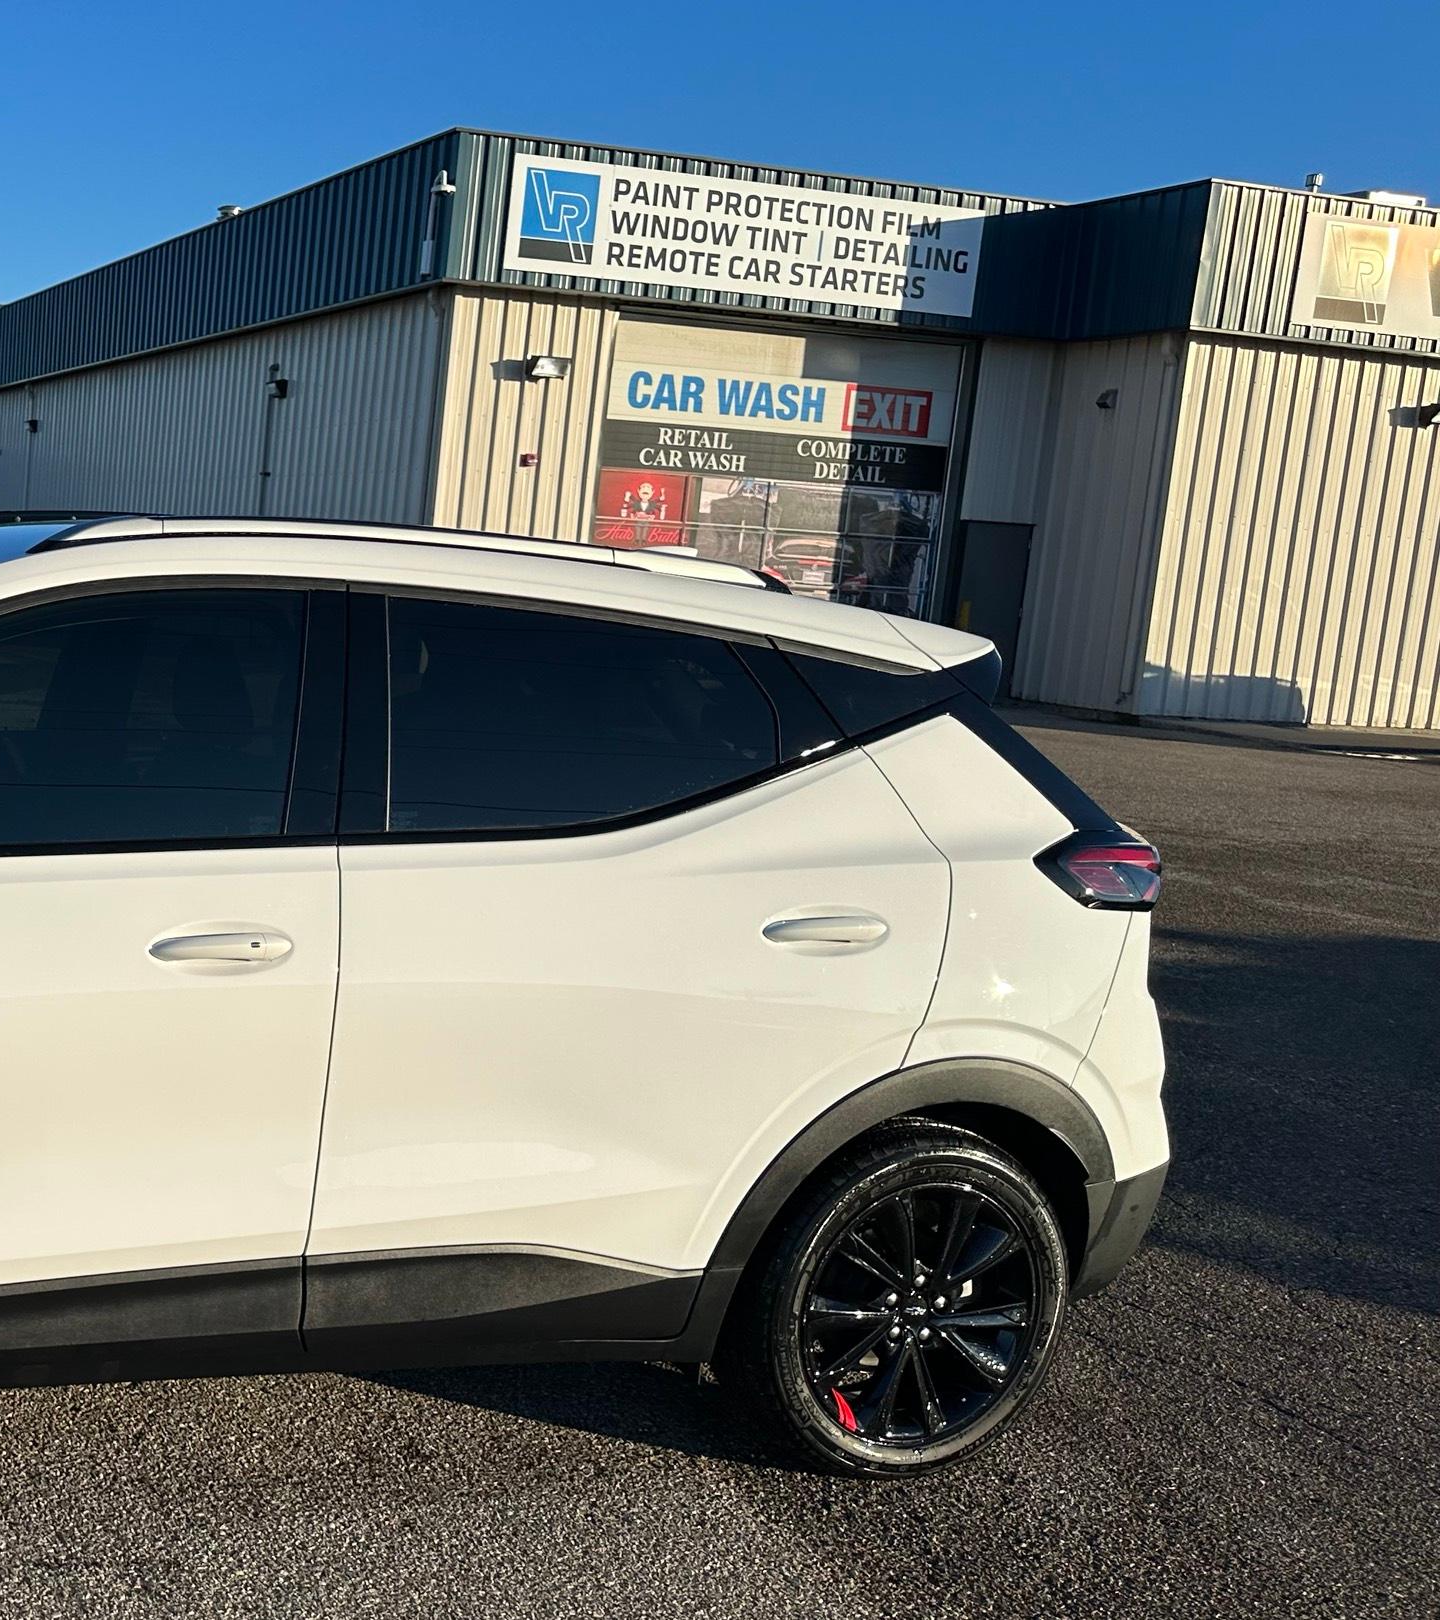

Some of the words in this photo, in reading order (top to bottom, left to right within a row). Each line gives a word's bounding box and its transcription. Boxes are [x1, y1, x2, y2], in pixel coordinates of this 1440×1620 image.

[613, 178, 699, 210] PAINT
[706, 190, 874, 231] PROTECTION
[881, 210, 942, 240] FILM
[611, 210, 739, 247] WINDOW
[746, 226, 807, 254] TINT
[833, 236, 969, 273] DETAILING
[606, 242, 721, 277] REMOTE
[728, 256, 781, 283] CAR
[789, 262, 926, 299] STARTERS
[628, 371, 705, 413] CAR
[718, 379, 826, 422] WASH
[846, 390, 927, 432] EXIT
[658, 427, 733, 450] RETAIL
[796, 439, 906, 464] COMPLETE
[639, 447, 683, 468] CAR
[688, 451, 746, 473] WASH
[812, 461, 886, 484] DETAIL
